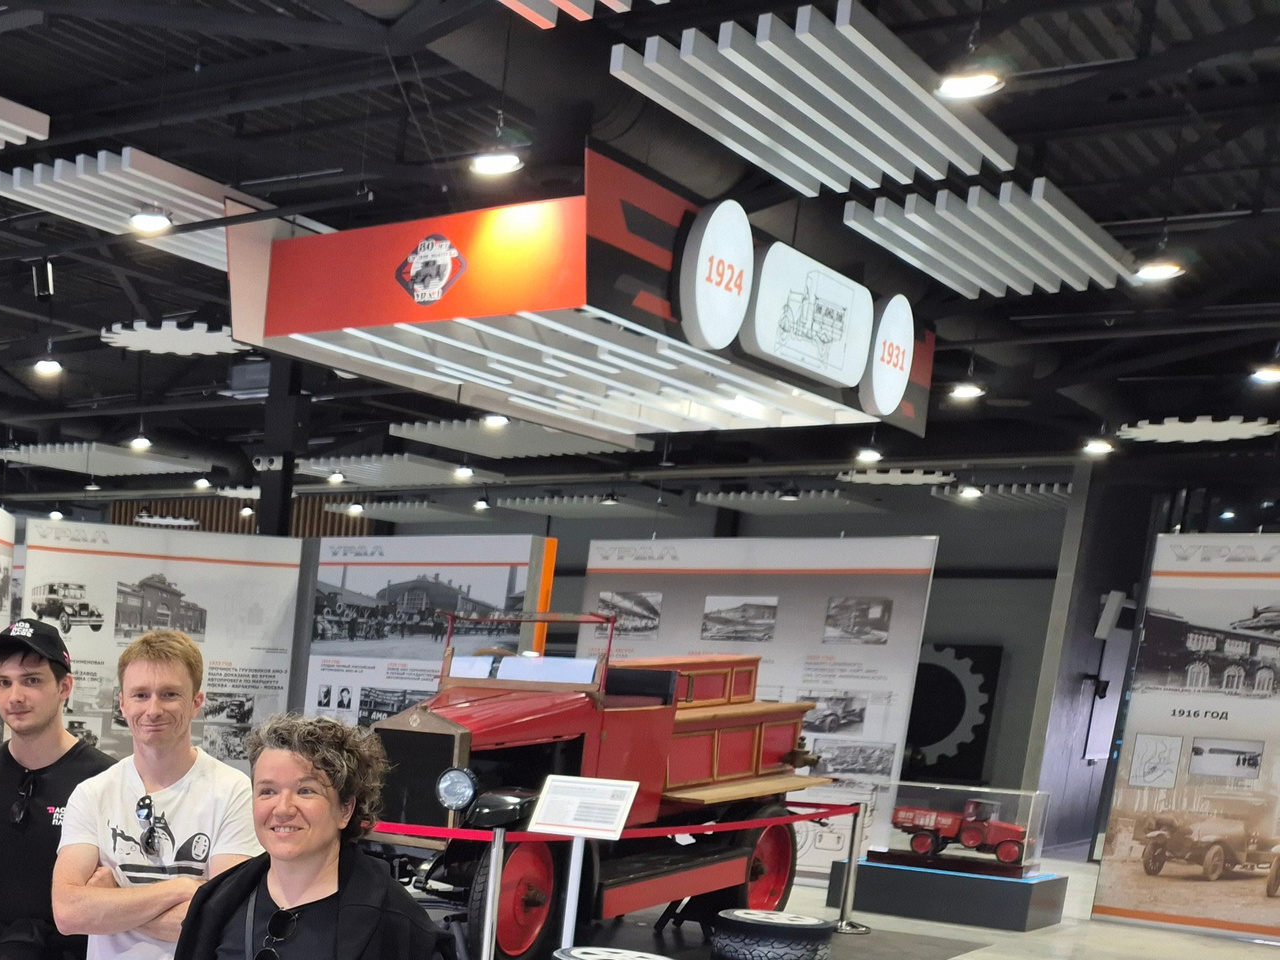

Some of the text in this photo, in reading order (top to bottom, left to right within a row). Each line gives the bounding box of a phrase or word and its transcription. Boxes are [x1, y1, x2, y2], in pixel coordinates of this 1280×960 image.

[705, 256, 744, 296] 1924
[880, 340, 906, 371] 1931
[1171, 709, 1229, 720] 1916 ГОД
